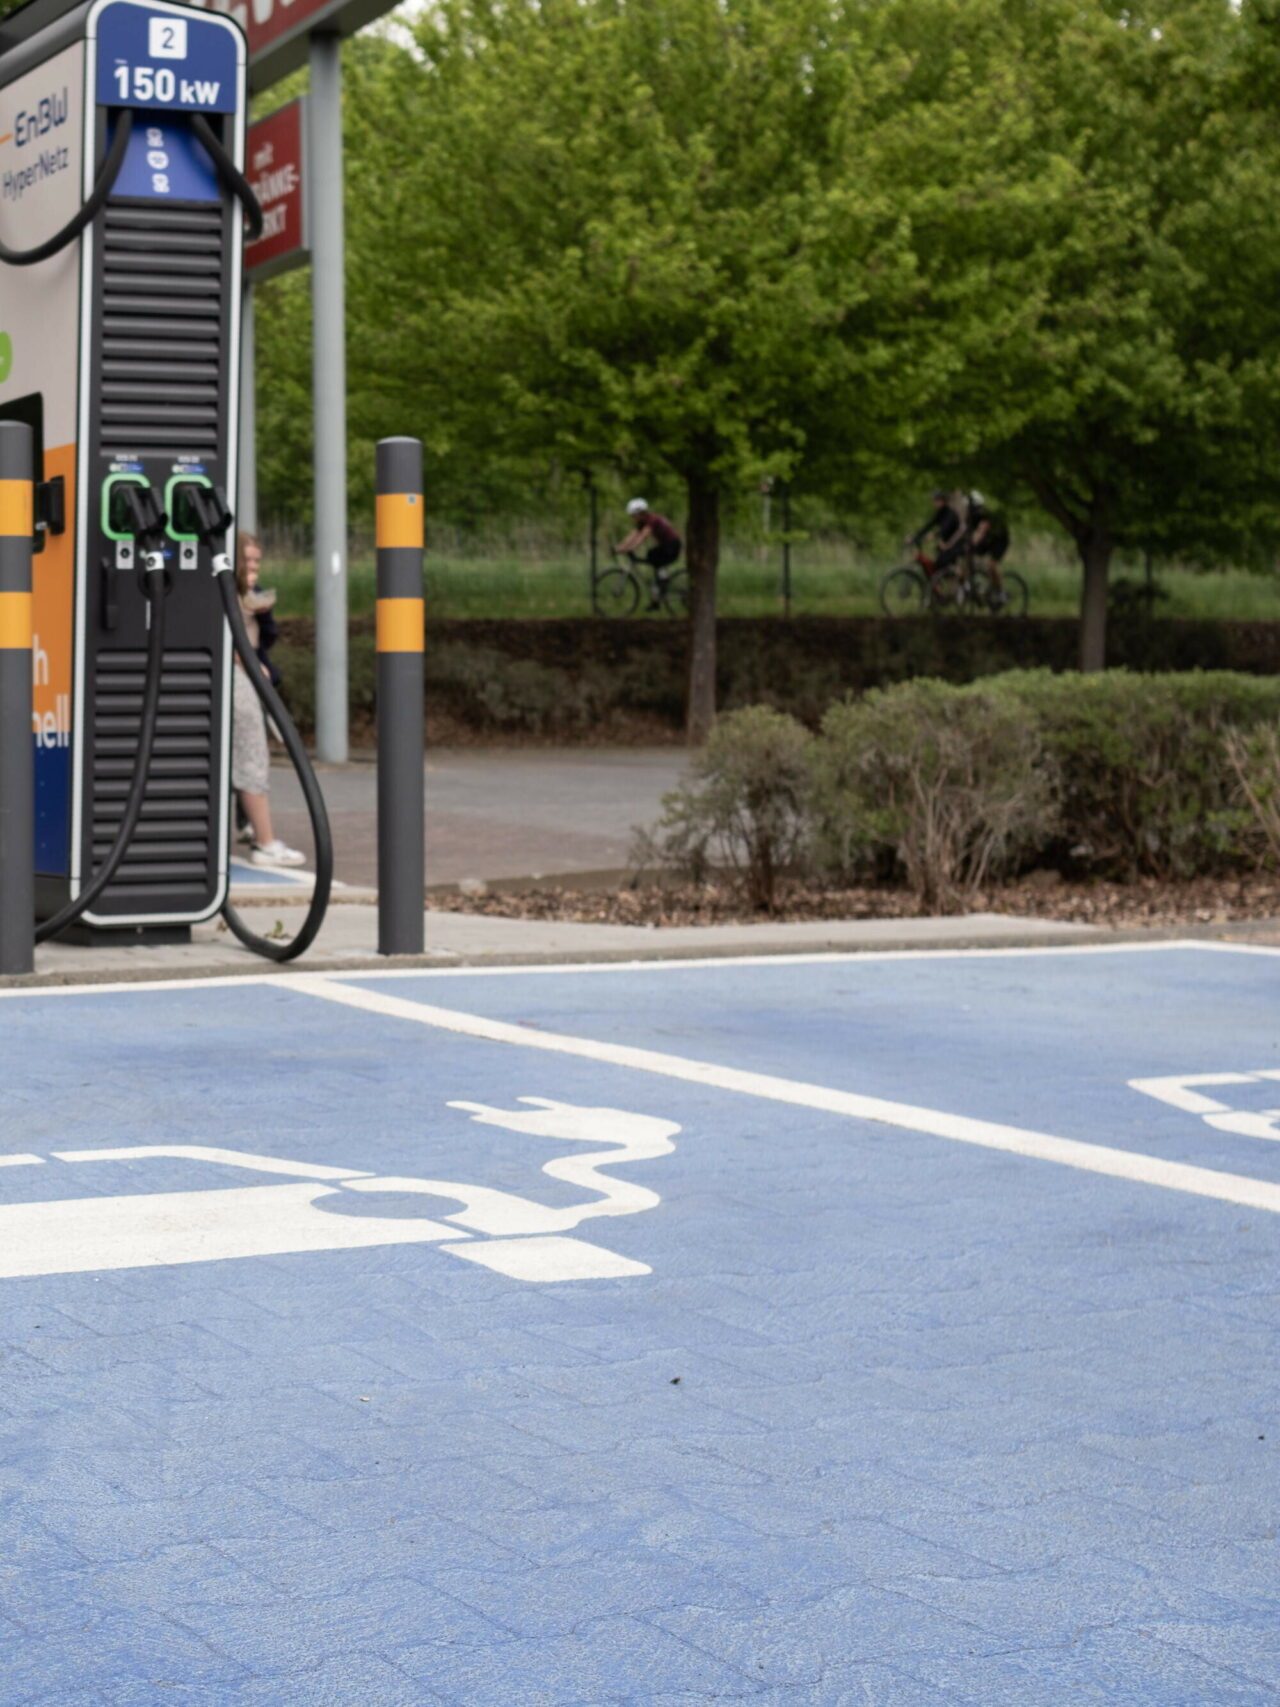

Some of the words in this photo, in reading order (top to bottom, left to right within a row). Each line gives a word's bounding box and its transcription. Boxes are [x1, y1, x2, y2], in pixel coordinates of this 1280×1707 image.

[160, 26, 176, 50] 2
[114, 65, 176, 102] 150
[179, 79, 221, 105] kW
[14, 85, 68, 148] EnBW
[2, 145, 69, 202] HyperNetz
